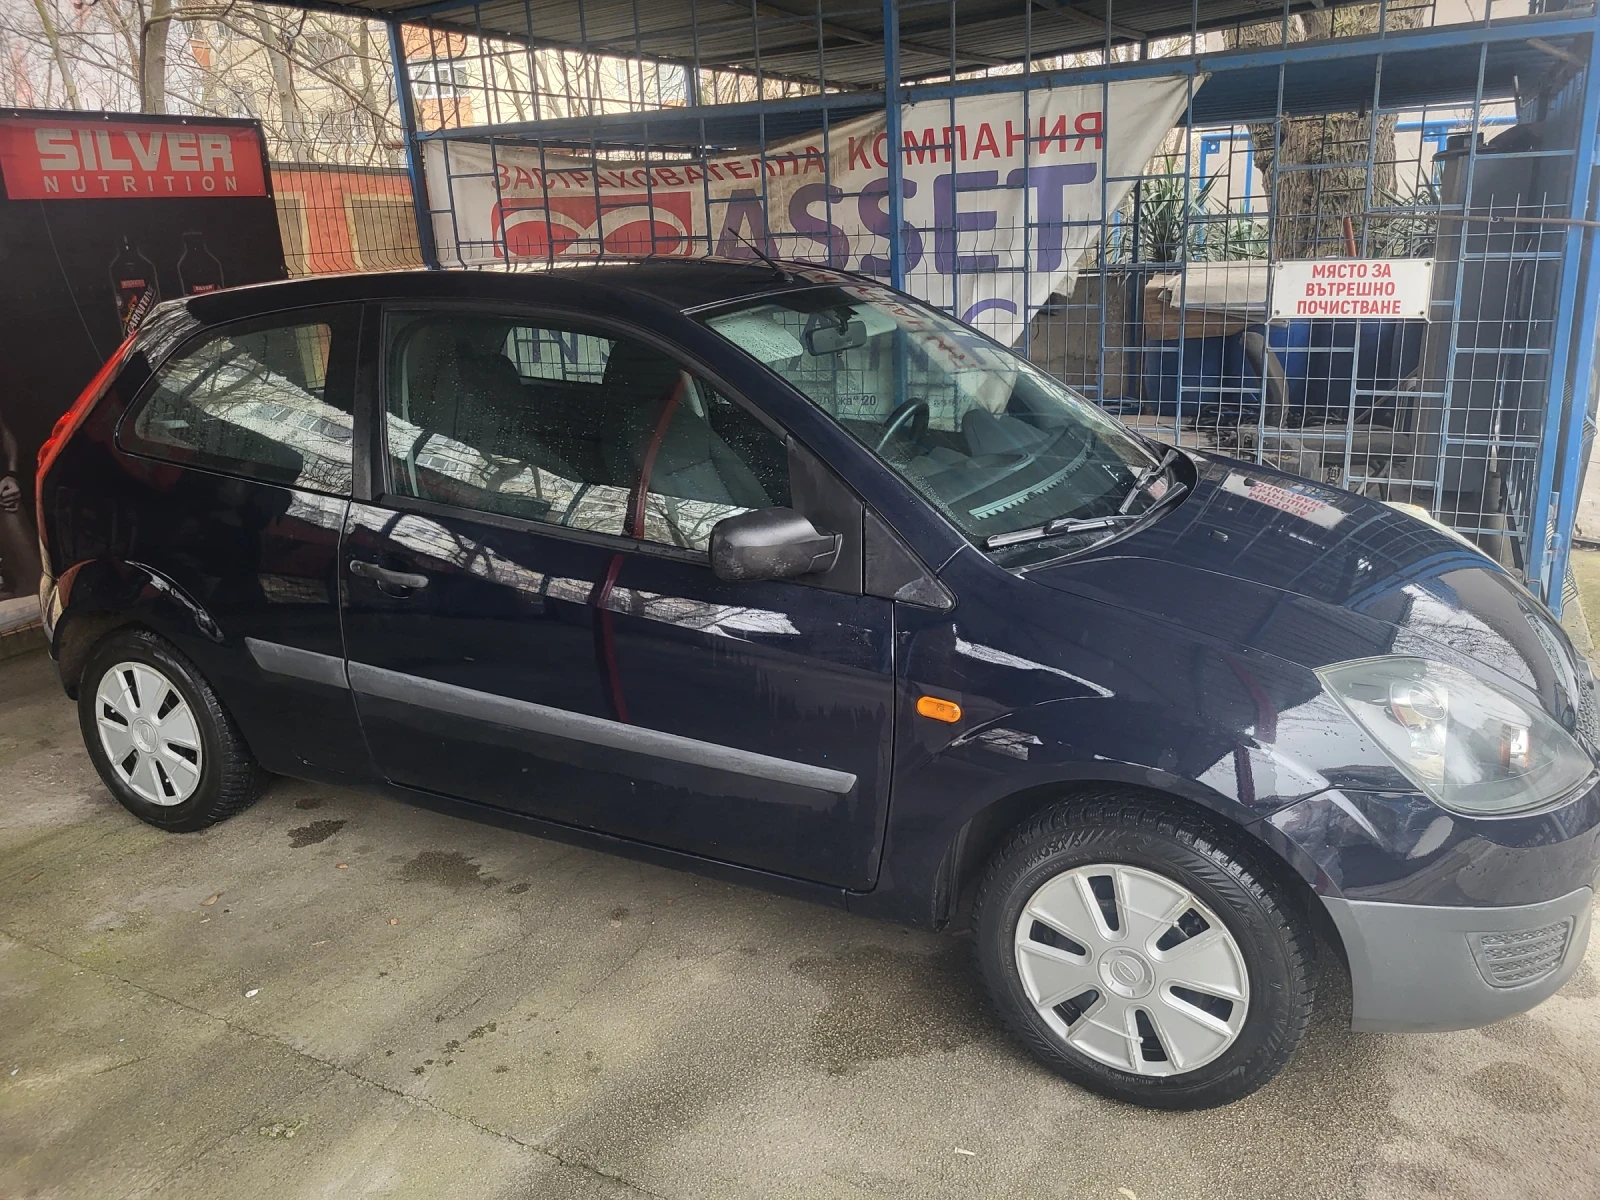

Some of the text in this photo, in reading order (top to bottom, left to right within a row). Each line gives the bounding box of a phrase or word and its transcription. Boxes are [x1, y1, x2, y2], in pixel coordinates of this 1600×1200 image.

[34, 128, 235, 172] SILVER
[491, 111, 1103, 191] ЗАСТРАХОВАТЕЛНА КОМПАНИЯ
[43, 175, 238, 193] NUTRITION
[715, 162, 1098, 278] ASSET
[1312, 263, 1392, 279] МЯСТО ЗА
[1305, 281, 1396, 297] ВЪТРЕШНО
[1296, 299, 1402, 315] ПОЧИСТВАНЕ
